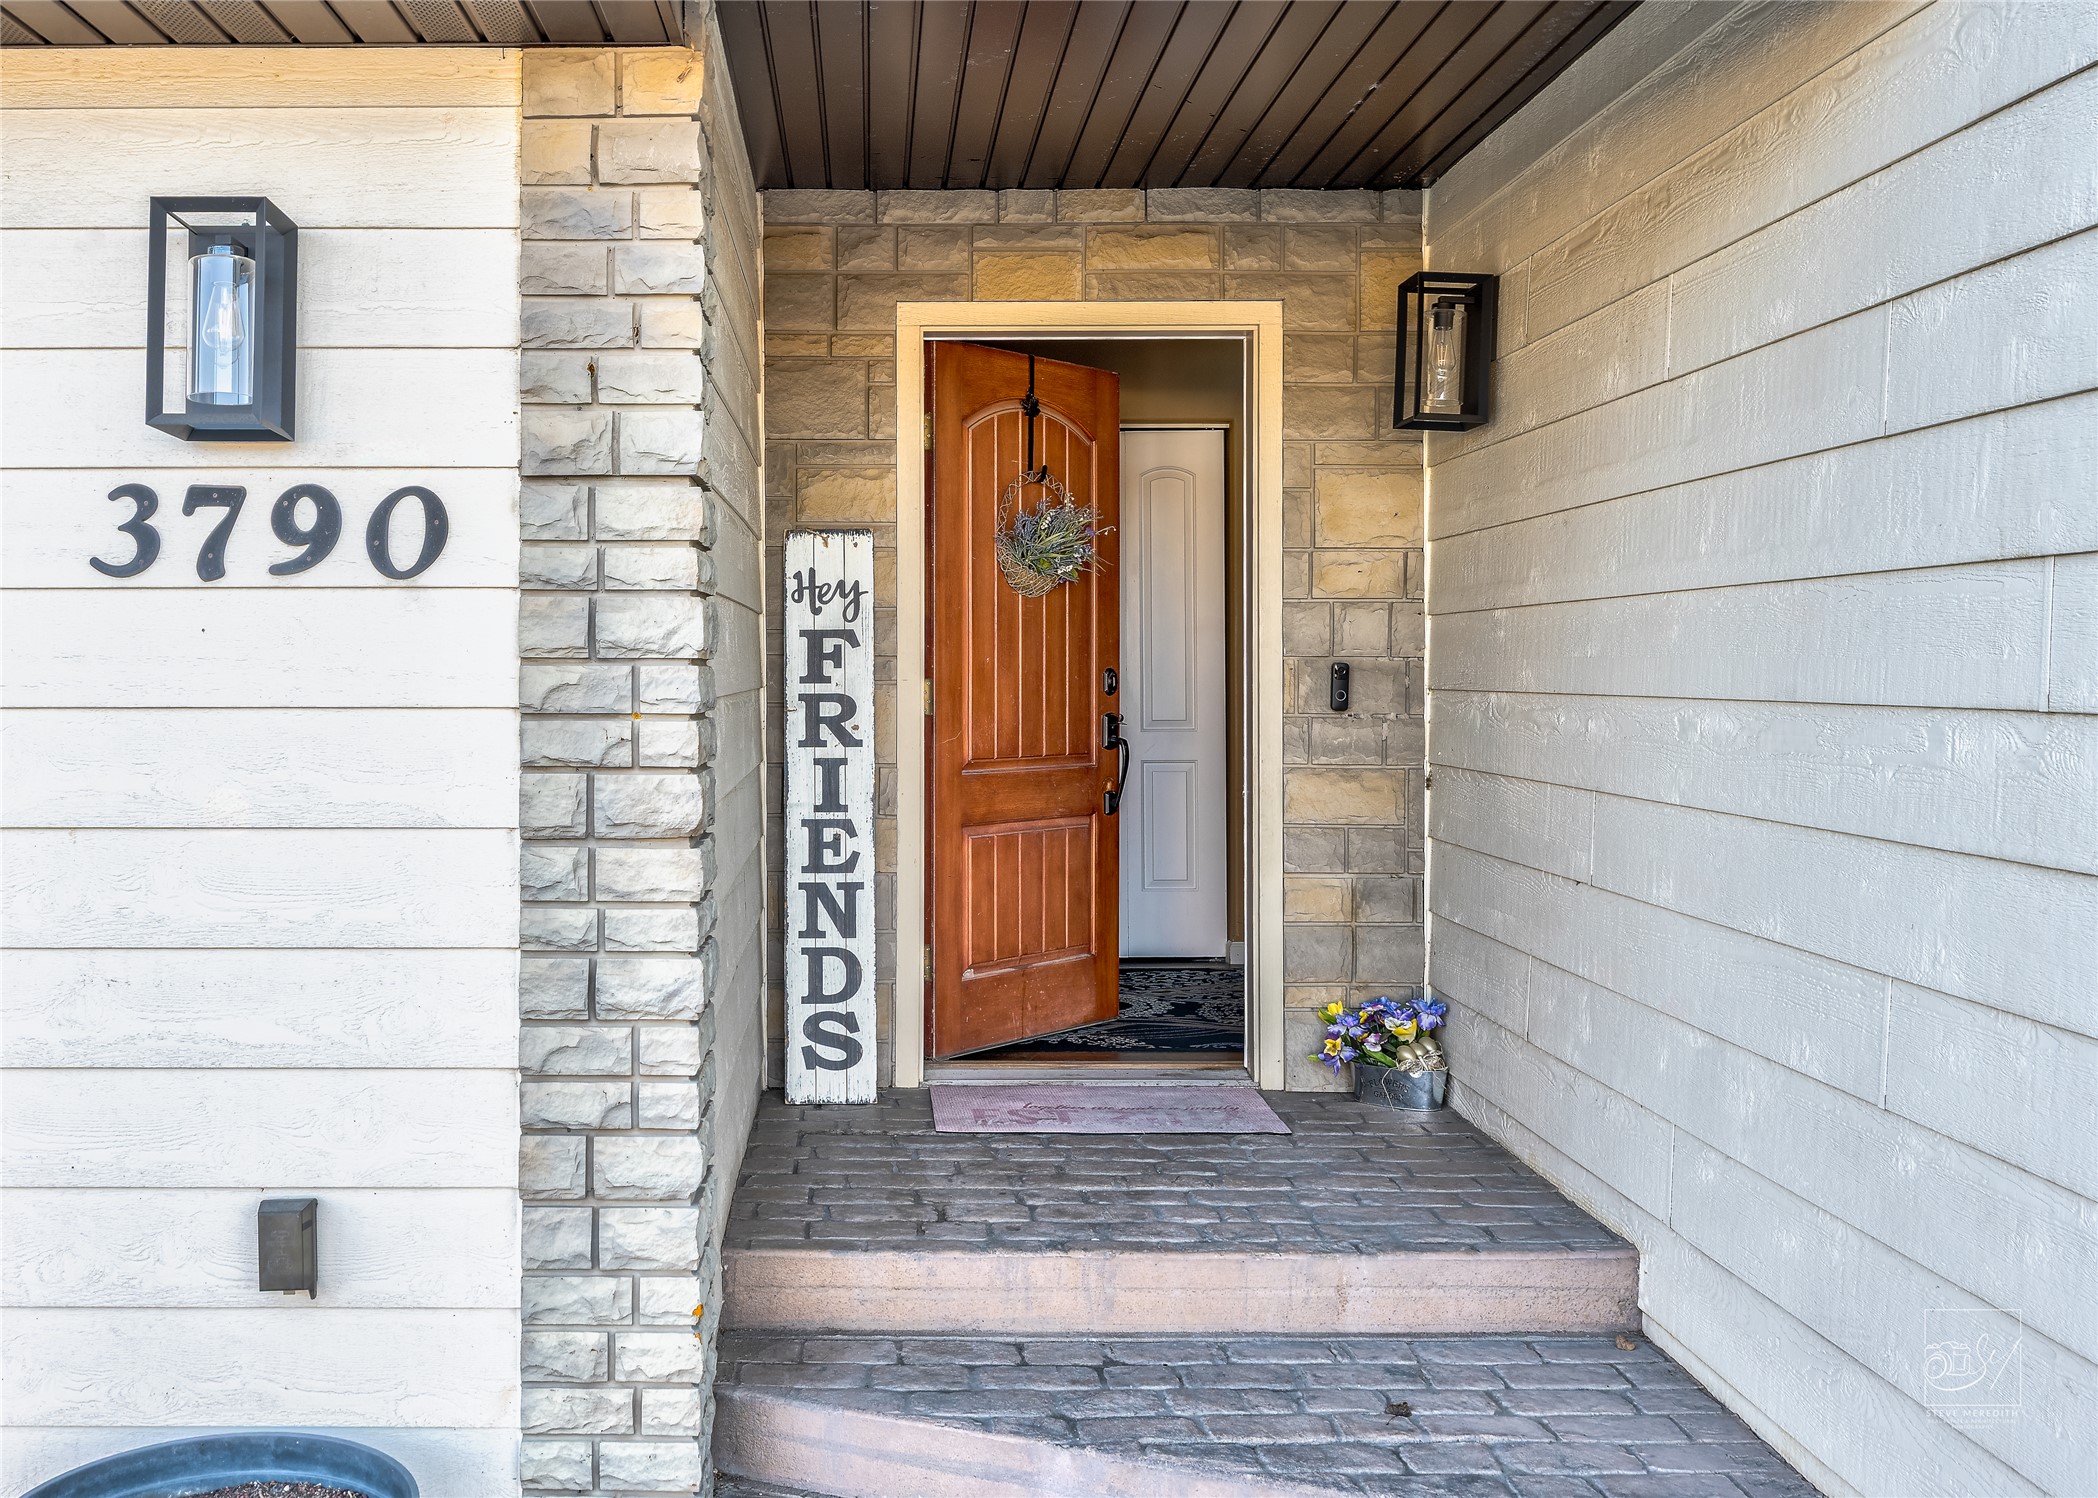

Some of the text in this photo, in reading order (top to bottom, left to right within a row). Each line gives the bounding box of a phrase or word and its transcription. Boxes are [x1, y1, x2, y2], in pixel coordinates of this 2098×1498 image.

[89, 483, 449, 582] 3790
[791, 567, 869, 623] Hey
[798, 629, 865, 1072] FRIENDS
